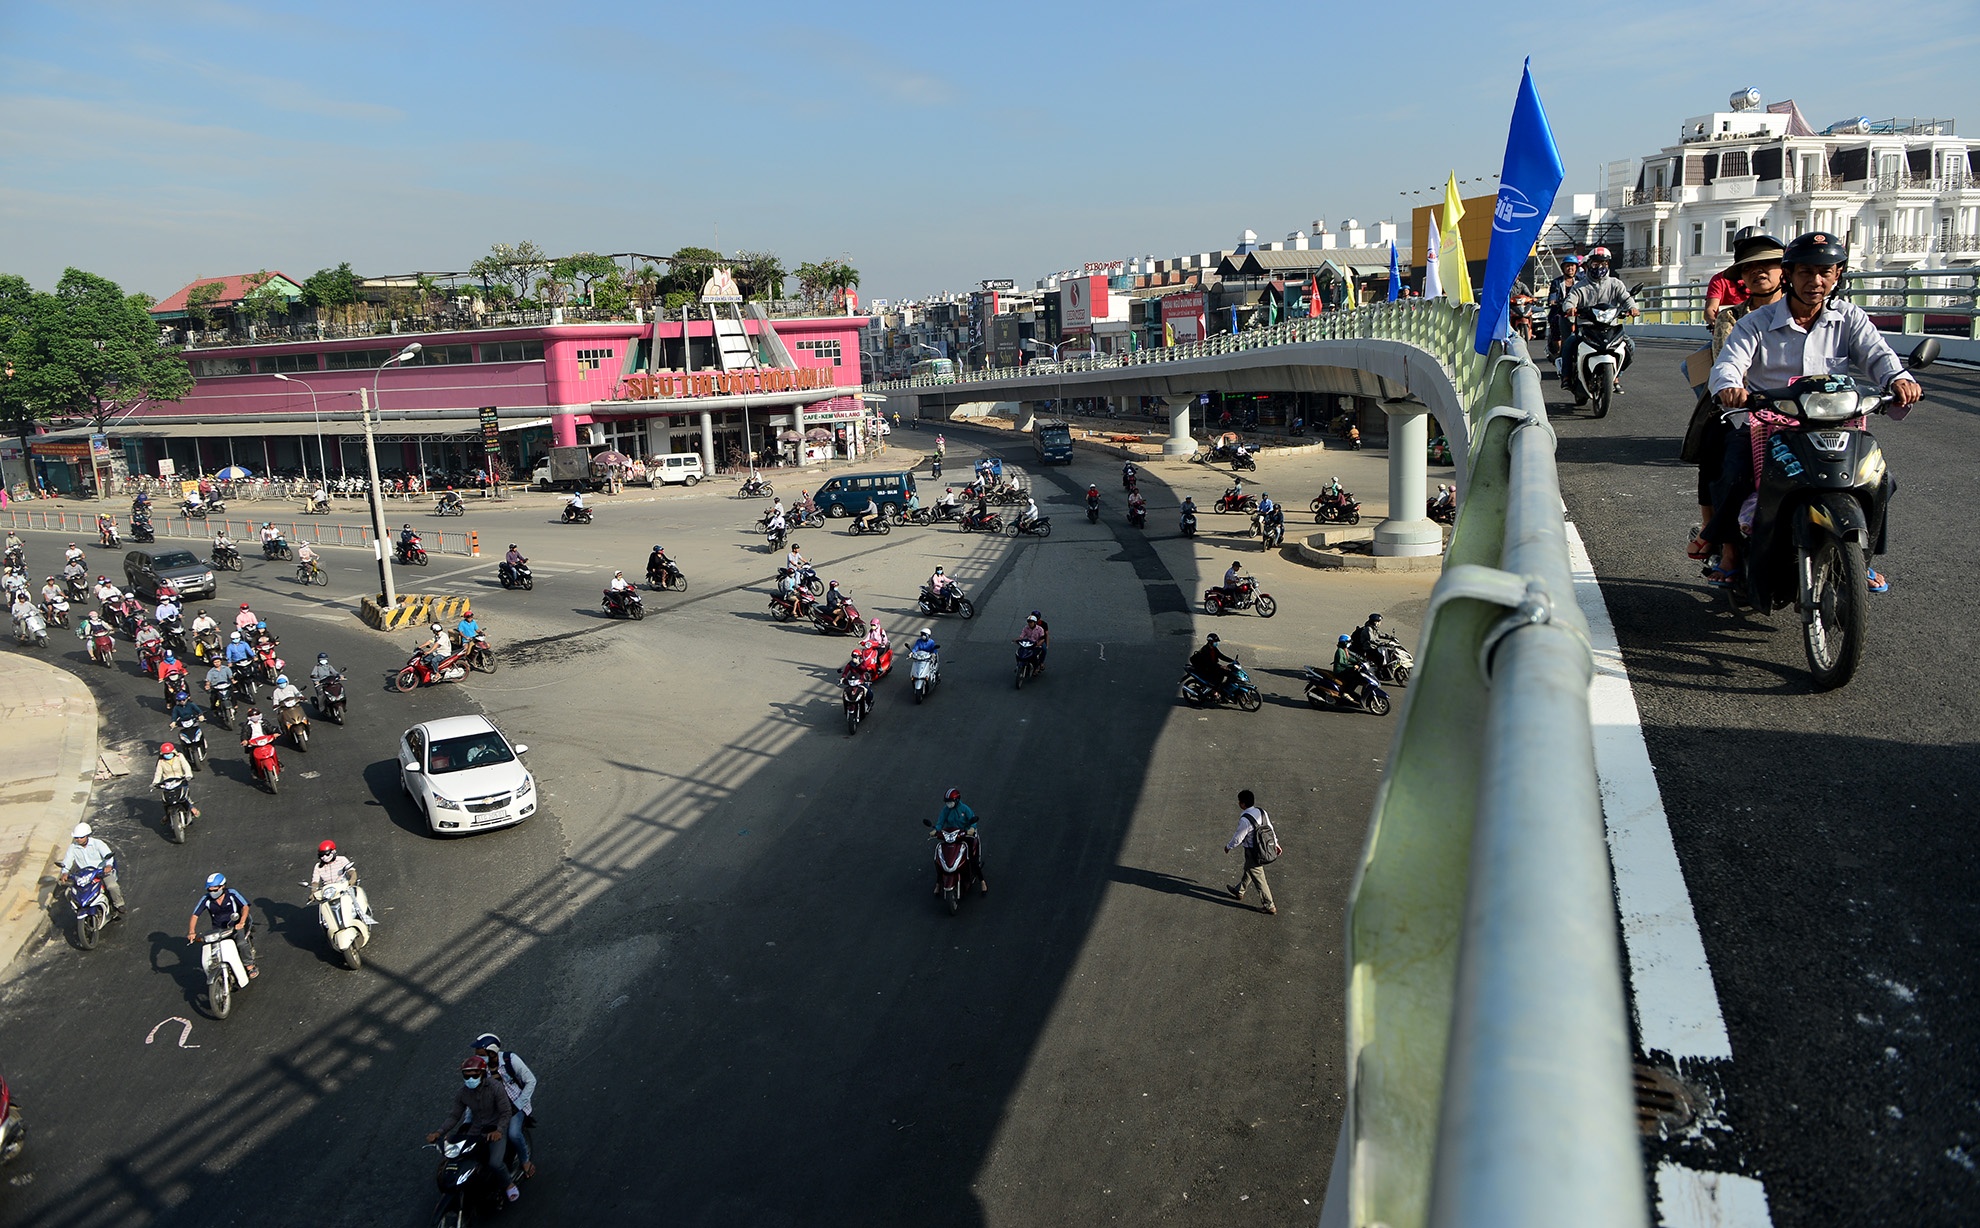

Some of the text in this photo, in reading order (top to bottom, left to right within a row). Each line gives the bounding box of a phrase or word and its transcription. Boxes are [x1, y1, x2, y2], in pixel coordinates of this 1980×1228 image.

[1084, 260, 1124, 271] BIBO MART
[627, 374, 674, 399] SIÊU
[716, 369, 755, 393] VĂN
